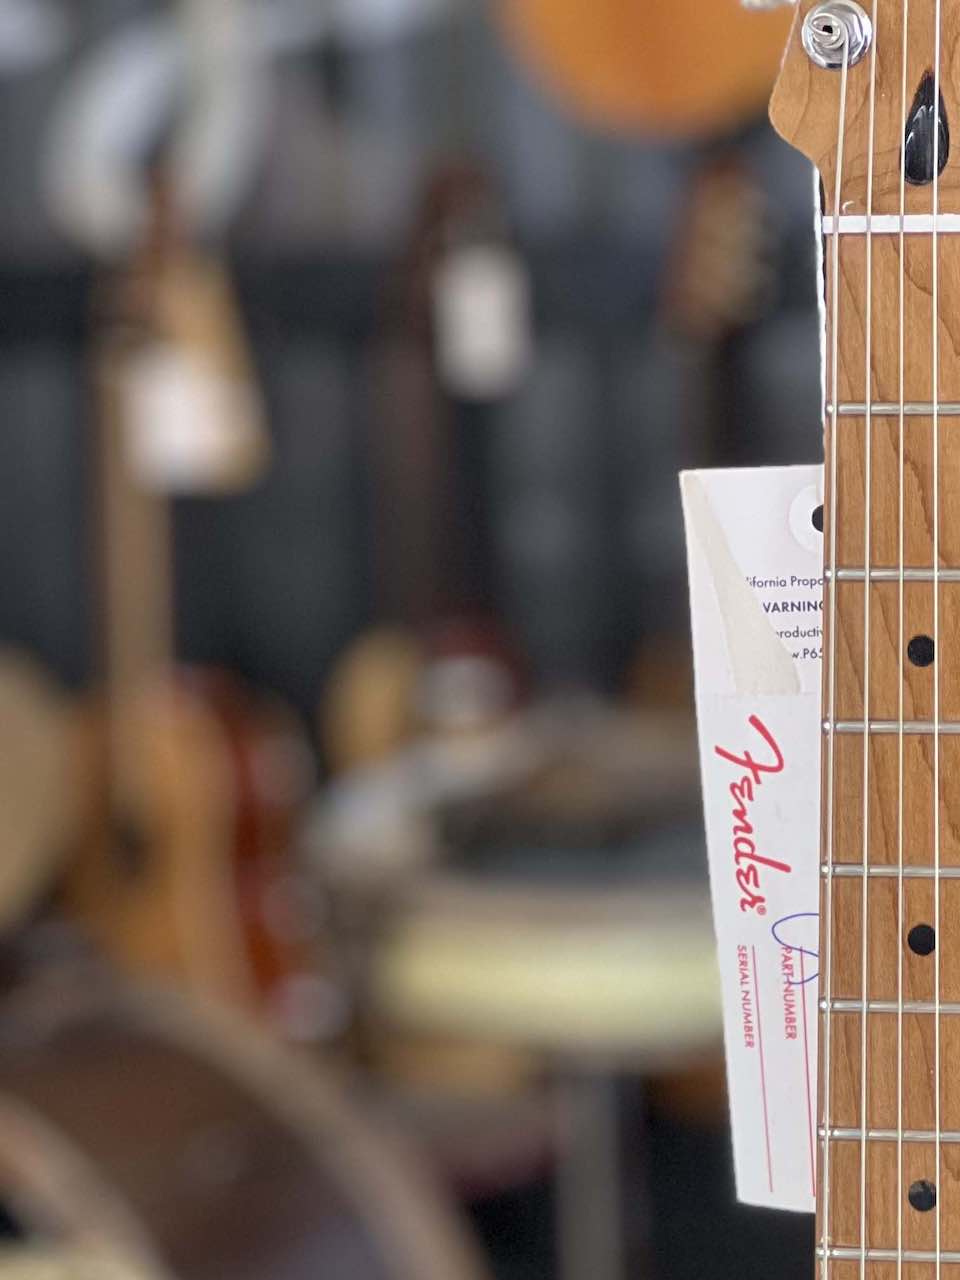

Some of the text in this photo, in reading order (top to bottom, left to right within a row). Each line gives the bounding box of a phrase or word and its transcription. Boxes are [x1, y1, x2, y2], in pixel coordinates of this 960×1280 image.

[737, 944, 755, 1048] SERIAL NUMBER
[781, 946, 797, 1040] PART NUMBER
